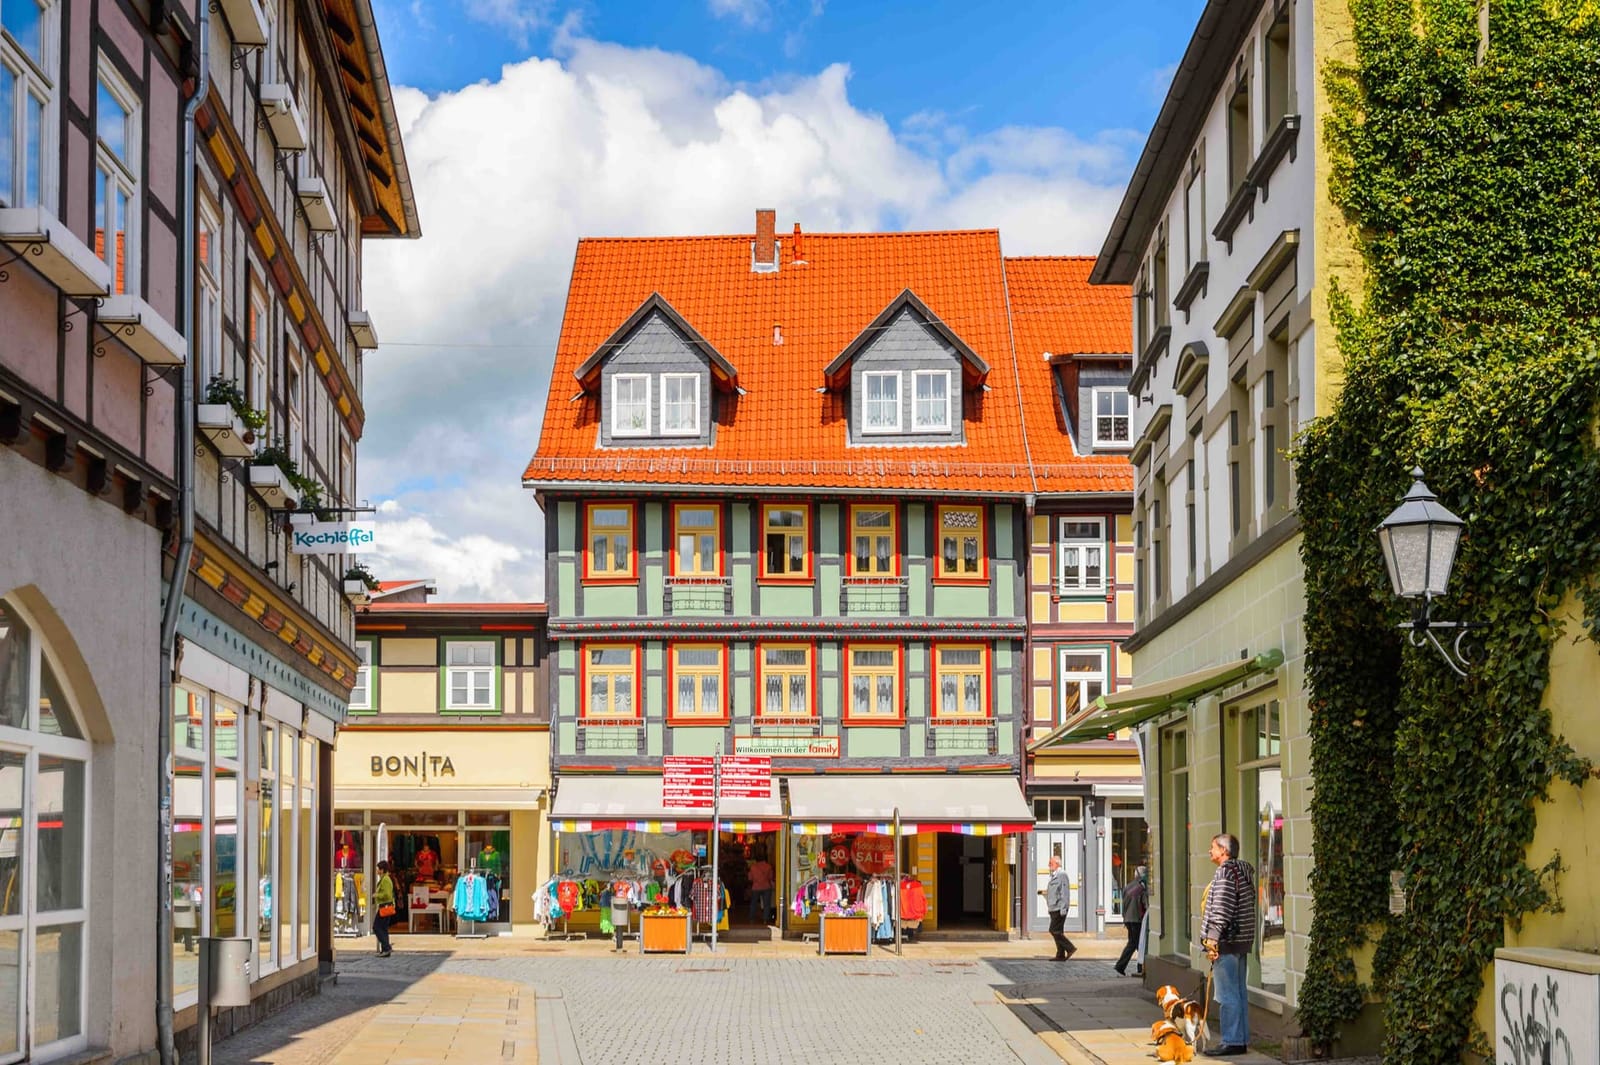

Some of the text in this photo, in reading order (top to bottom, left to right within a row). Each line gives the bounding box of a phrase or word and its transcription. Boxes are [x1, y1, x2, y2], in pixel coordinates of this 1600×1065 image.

[294, 528, 374, 547] Kochlöffel
[793, 746, 806, 754] der
[808, 743, 838, 755] family
